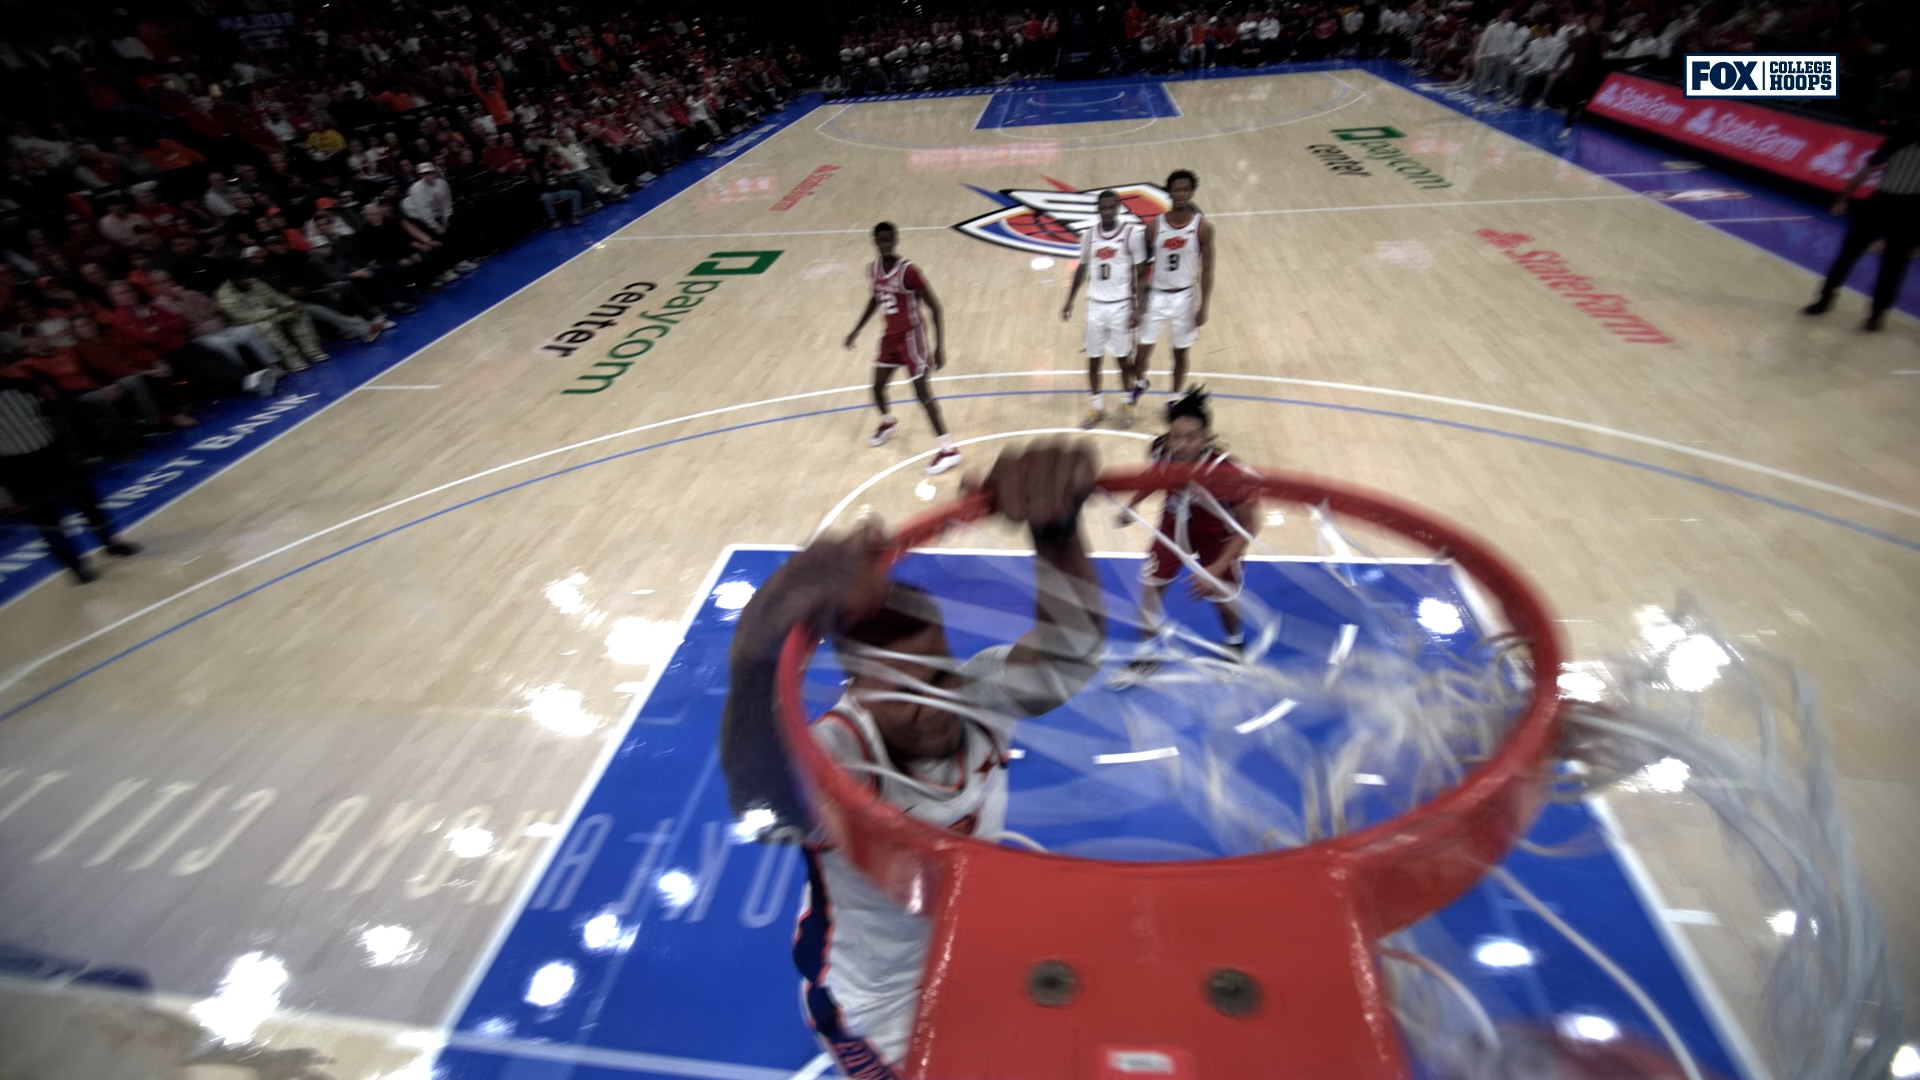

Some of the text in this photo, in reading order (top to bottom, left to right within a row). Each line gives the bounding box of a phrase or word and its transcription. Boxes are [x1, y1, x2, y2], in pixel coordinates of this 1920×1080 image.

[1304, 143, 1373, 177] center
[1346, 140, 1454, 190] paycom
[541, 281, 659, 358] center
[560, 279, 725, 395] paycom
[186, 391, 321, 450] BANK
